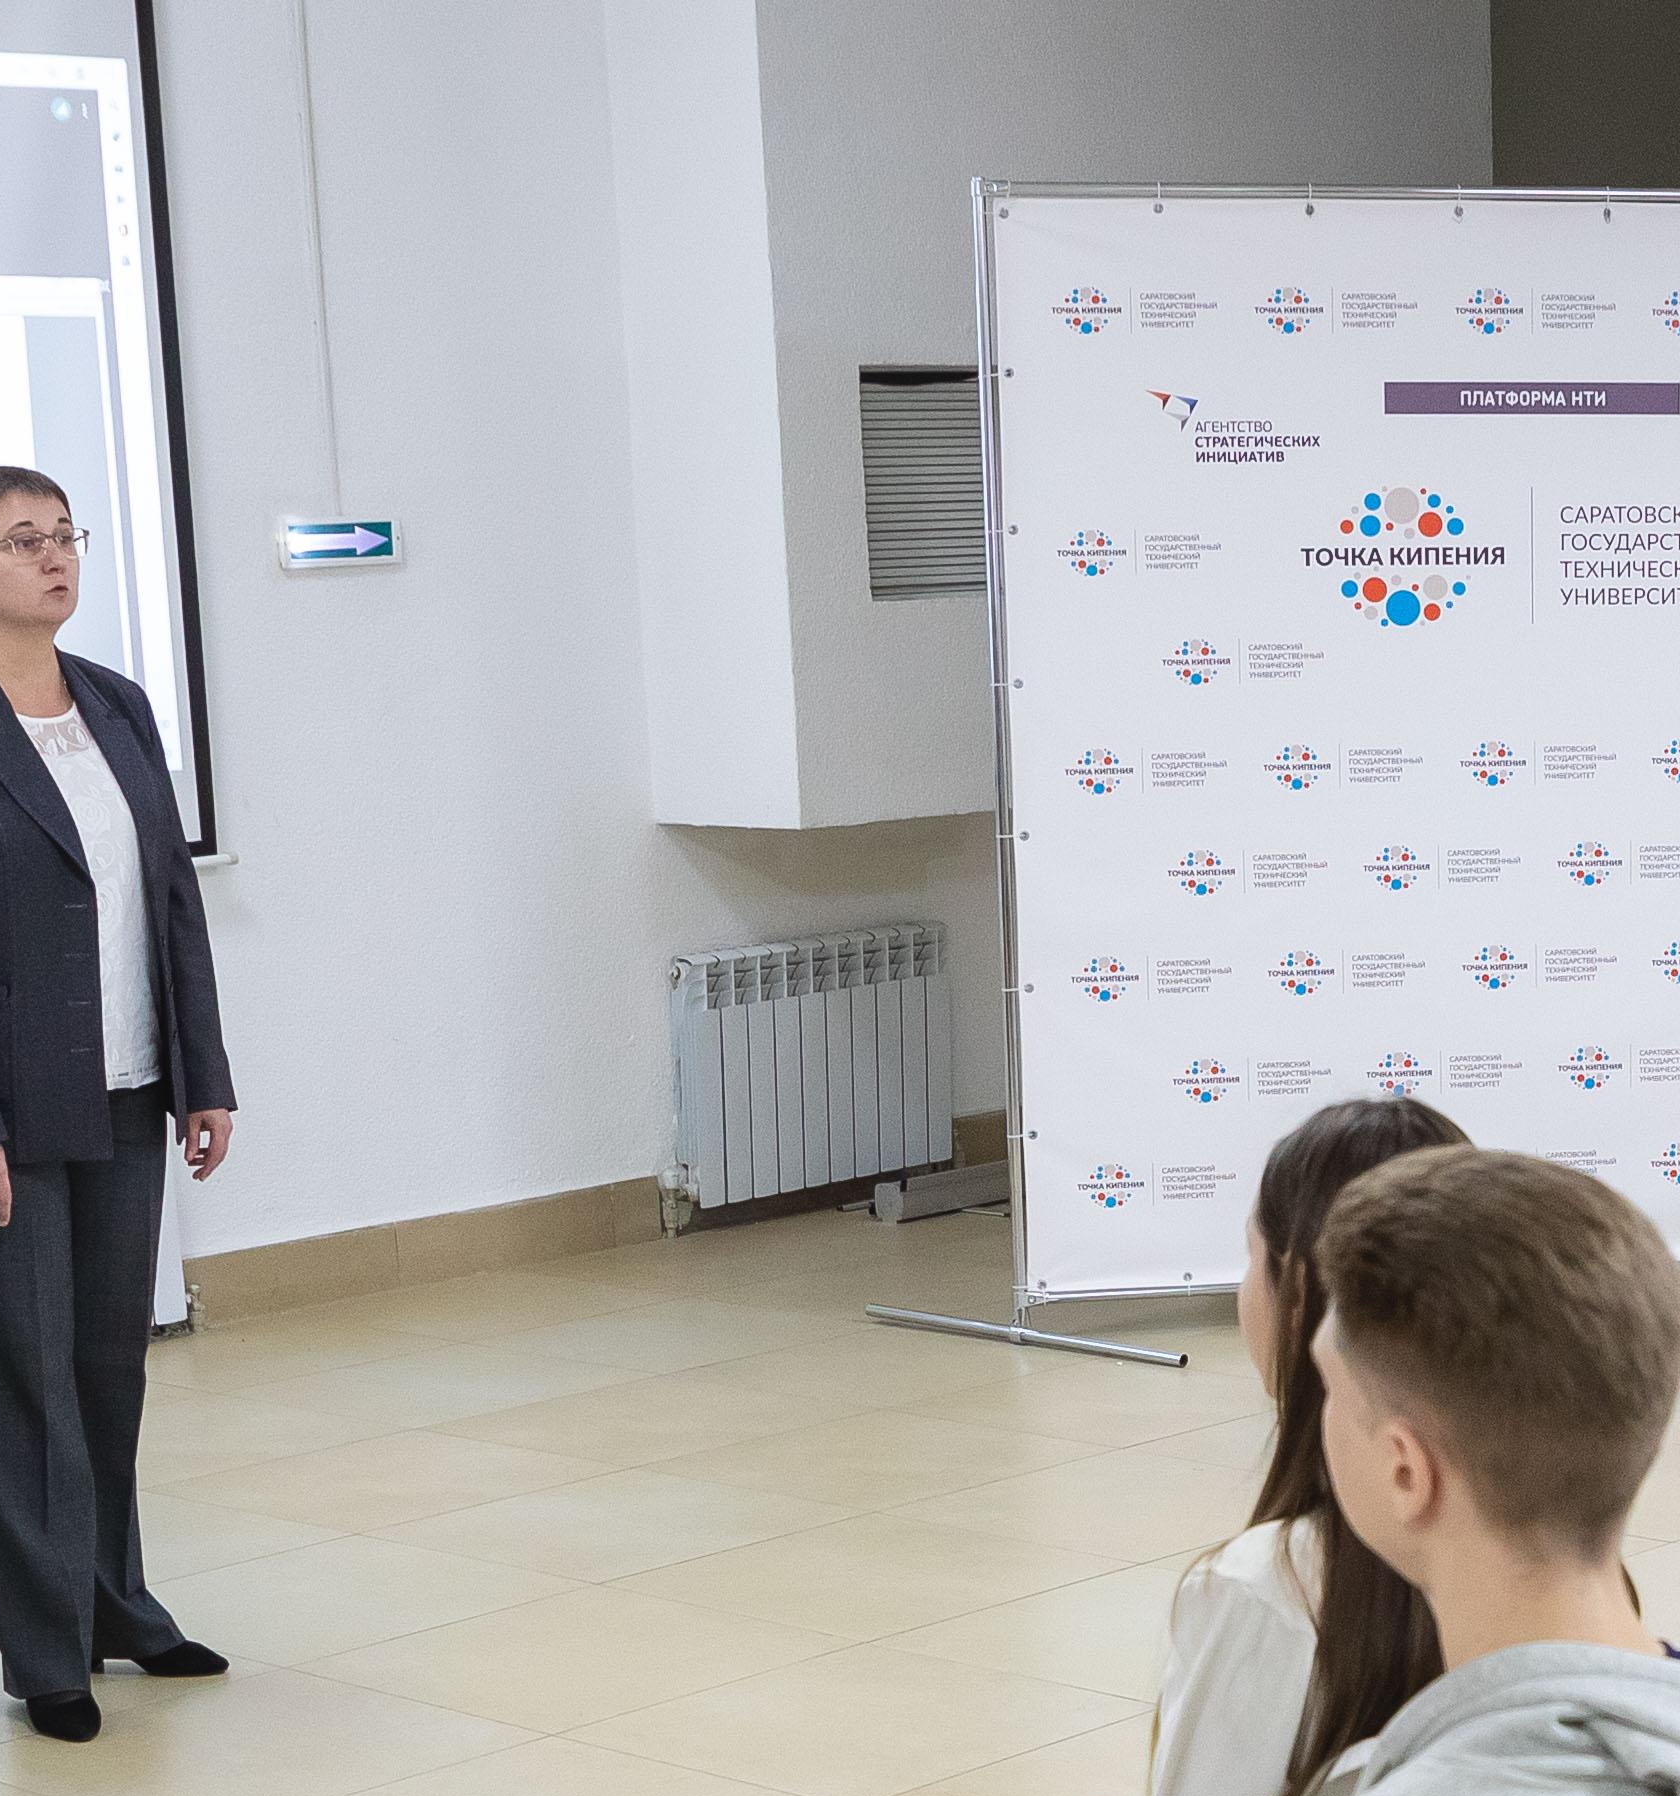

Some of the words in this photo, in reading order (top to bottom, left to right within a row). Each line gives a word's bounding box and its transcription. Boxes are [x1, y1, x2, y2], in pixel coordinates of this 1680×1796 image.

[1140, 302, 1218, 310] ГОСУДАРСТВЕННЫЙ
[1141, 311, 1196, 319] ТЕХНИЧЕСКИЙ
[1460, 390, 1566, 407] ПЛАТФОРМА
[1572, 389, 1606, 407] НТИ
[1195, 420, 1273, 433] АГЕНТСТВО
[1195, 434, 1320, 449] СТРАТЕГИЧЕСКИХ
[1195, 449, 1285, 464] ИНИЦИАТИВ
[1301, 548, 1384, 568] ТОЧКА
[1389, 547, 1505, 567] КИПЕНИЯ
[1349, 757, 1423, 765] ГОСУДАРСТВЕННЫЙ
[1162, 1165, 1215, 1173] САРАТОВСКИЙ
[1162, 1174, 1236, 1182] ГОСУДАРСТВЕННЫЙ
[1163, 1192, 1214, 1200] УНИВЕРСИТЕТ
